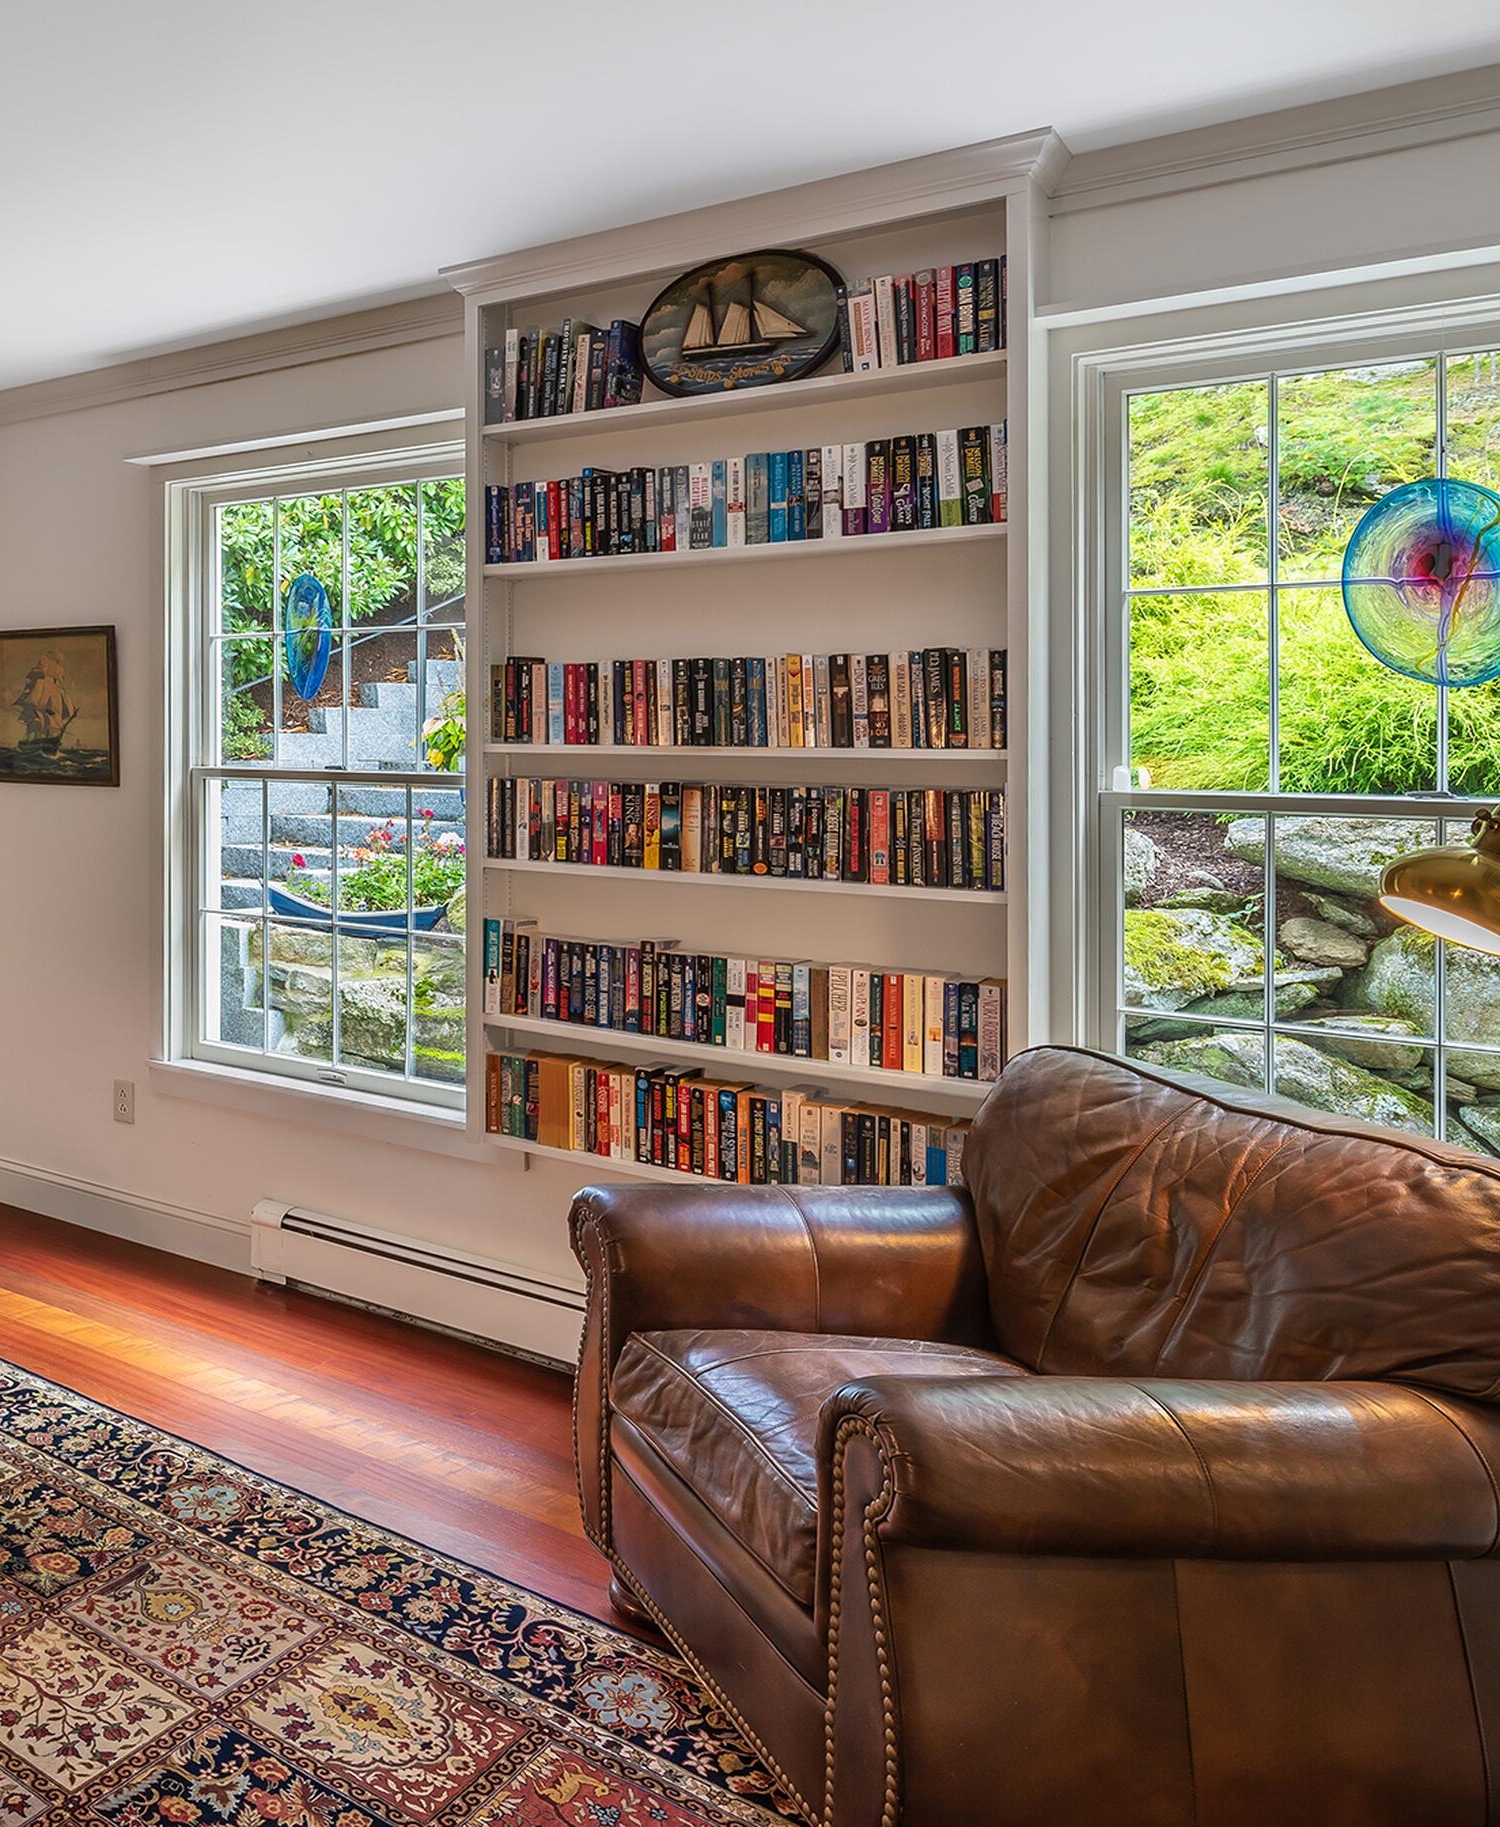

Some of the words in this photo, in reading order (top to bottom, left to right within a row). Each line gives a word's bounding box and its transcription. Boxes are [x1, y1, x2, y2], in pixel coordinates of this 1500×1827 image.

[937, 280, 951, 314] DECEPTION
[959, 287, 972, 305] DAN
[938, 315, 951, 334] POINT
[959, 305, 972, 334] BROWN
[562, 324, 570, 364] HOUDINI
[864, 327, 872, 354] BINCHY
[559, 367, 567, 390] GIRL
[944, 452, 953, 473] Nelson
[973, 447, 981, 477] NELSON
[996, 446, 1006, 467] Nelson
[847, 463, 858, 484] Nelson
[877, 456, 885, 484] NELSON
[692, 477, 700, 508] CRICHTON
[848, 484, 858, 506] DeMille
[922, 486, 930, 509] NIGHT
[945, 474, 953, 497] DeMille
[896, 499, 905, 524] GAME
[967, 494, 979, 523] COUNTRY
[976, 499, 985, 507] UP
[872, 507, 882, 524] COAST
[923, 510, 931, 527] FALL
[854, 668, 865, 688] LINDA
[927, 666, 940, 693] JAMES
[855, 688, 866, 712] HOWARD
[625, 795, 635, 824] KING
[831, 975, 848, 1012] PILCHER
[856, 999, 867, 1018] PLAIN
[982, 998, 999, 1020] NORA
[982, 1021, 999, 1053] ROBERTS
[725, 1111, 735, 1137] GERALD
[725, 1139, 735, 1172] SEYMOUR
